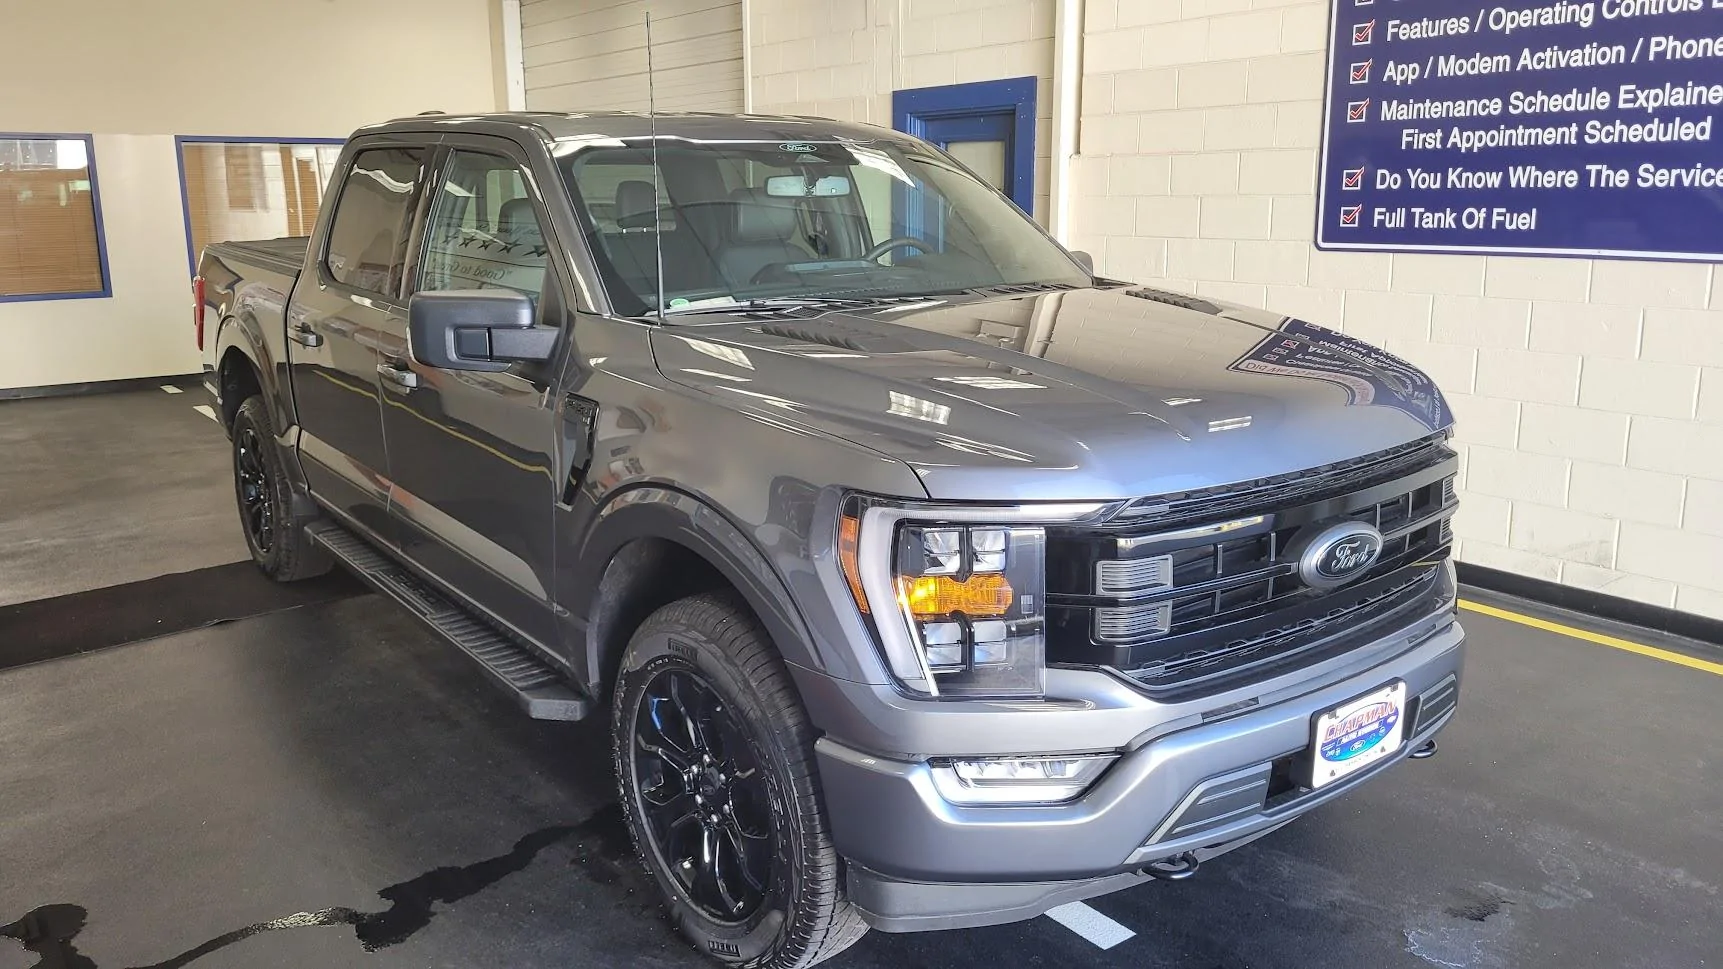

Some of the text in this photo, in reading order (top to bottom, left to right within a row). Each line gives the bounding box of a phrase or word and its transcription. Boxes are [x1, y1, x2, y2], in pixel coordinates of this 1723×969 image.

[1386, 15, 1470, 42] Features
[1488, 0, 1595, 35] Operating
[1601, 0, 1704, 20] Controls
[1382, 60, 1420, 86] App
[1437, 52, 1511, 78] Modem
[1515, 41, 1626, 72] Activation
[1648, 35, 1723, 62] Phone
[1380, 97, 1503, 121] Maintenance
[1508, 86, 1611, 116] Schedule
[1401, 115, 1713, 153] First Appointment Scheduled
[1375, 168, 1402, 190] Do
[1406, 167, 1442, 189] You
[1446, 167, 1503, 190] Know
[1508, 165, 1580, 189] Where
[1585, 164, 1630, 188] The
[1373, 207, 1537, 230] Full Tank Of Fuel
[1331, 540, 1370, 573] Ford
[1323, 700, 1397, 743] CHAPMAN
